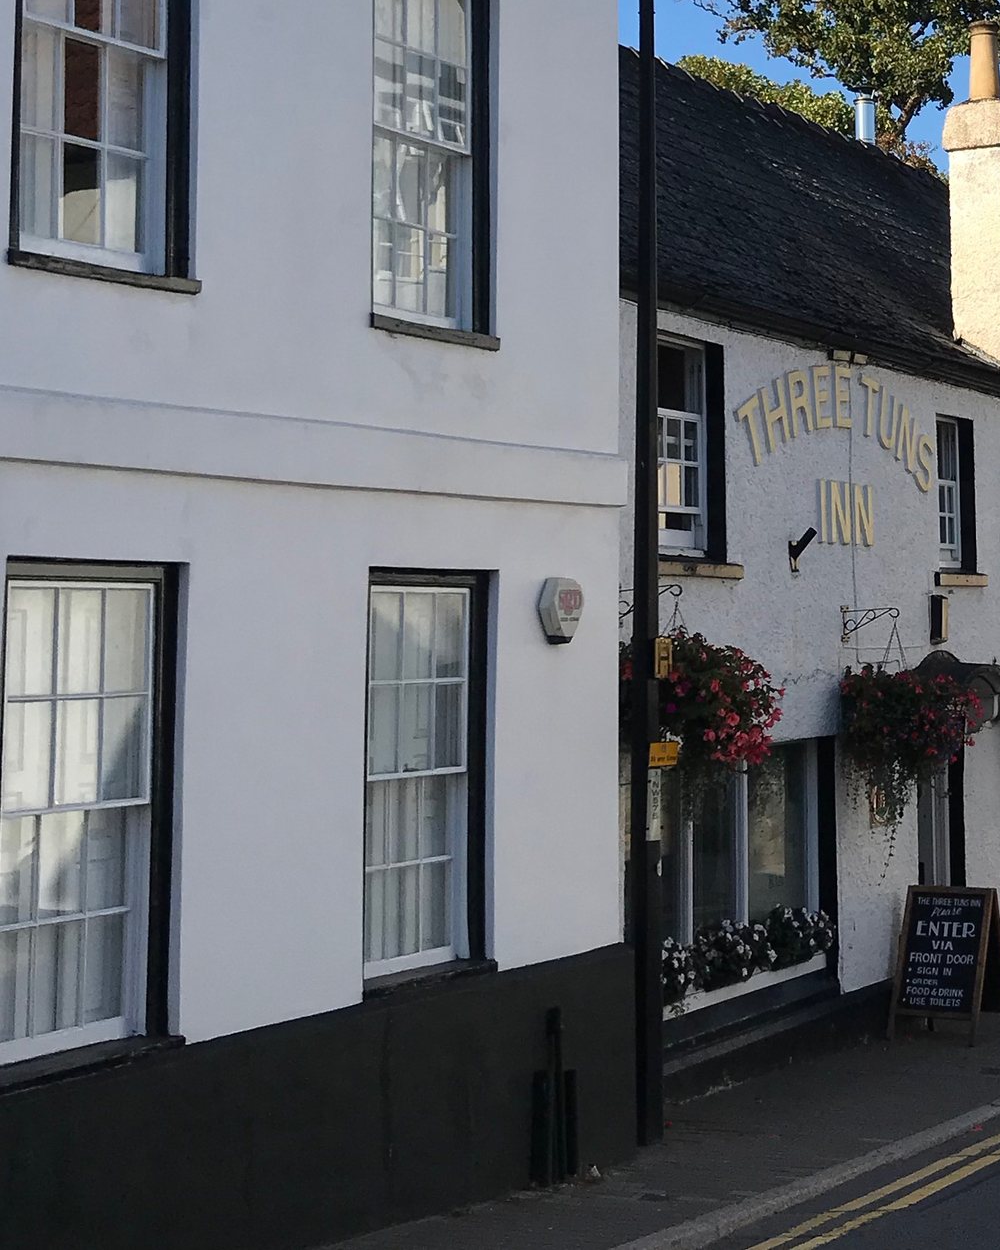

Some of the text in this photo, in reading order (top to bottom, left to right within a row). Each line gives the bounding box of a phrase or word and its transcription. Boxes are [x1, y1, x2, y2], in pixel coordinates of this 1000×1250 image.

[733, 365, 933, 493] THREE TUNS
[816, 477, 875, 546] INN
[918, 897, 930, 906] THE
[932, 897, 952, 906] THREE
[954, 898, 970, 907] TUNS
[916, 920, 976, 938] ENTER
[931, 940, 954, 951] VIA
[909, 952, 974, 965] FRONT DOOR
[916, 967, 952, 976] SIGN IN
[906, 988, 931, 996] FOOD
[938, 988, 964, 997] DRINK
[910, 997, 961, 1007] USE TOILETS
